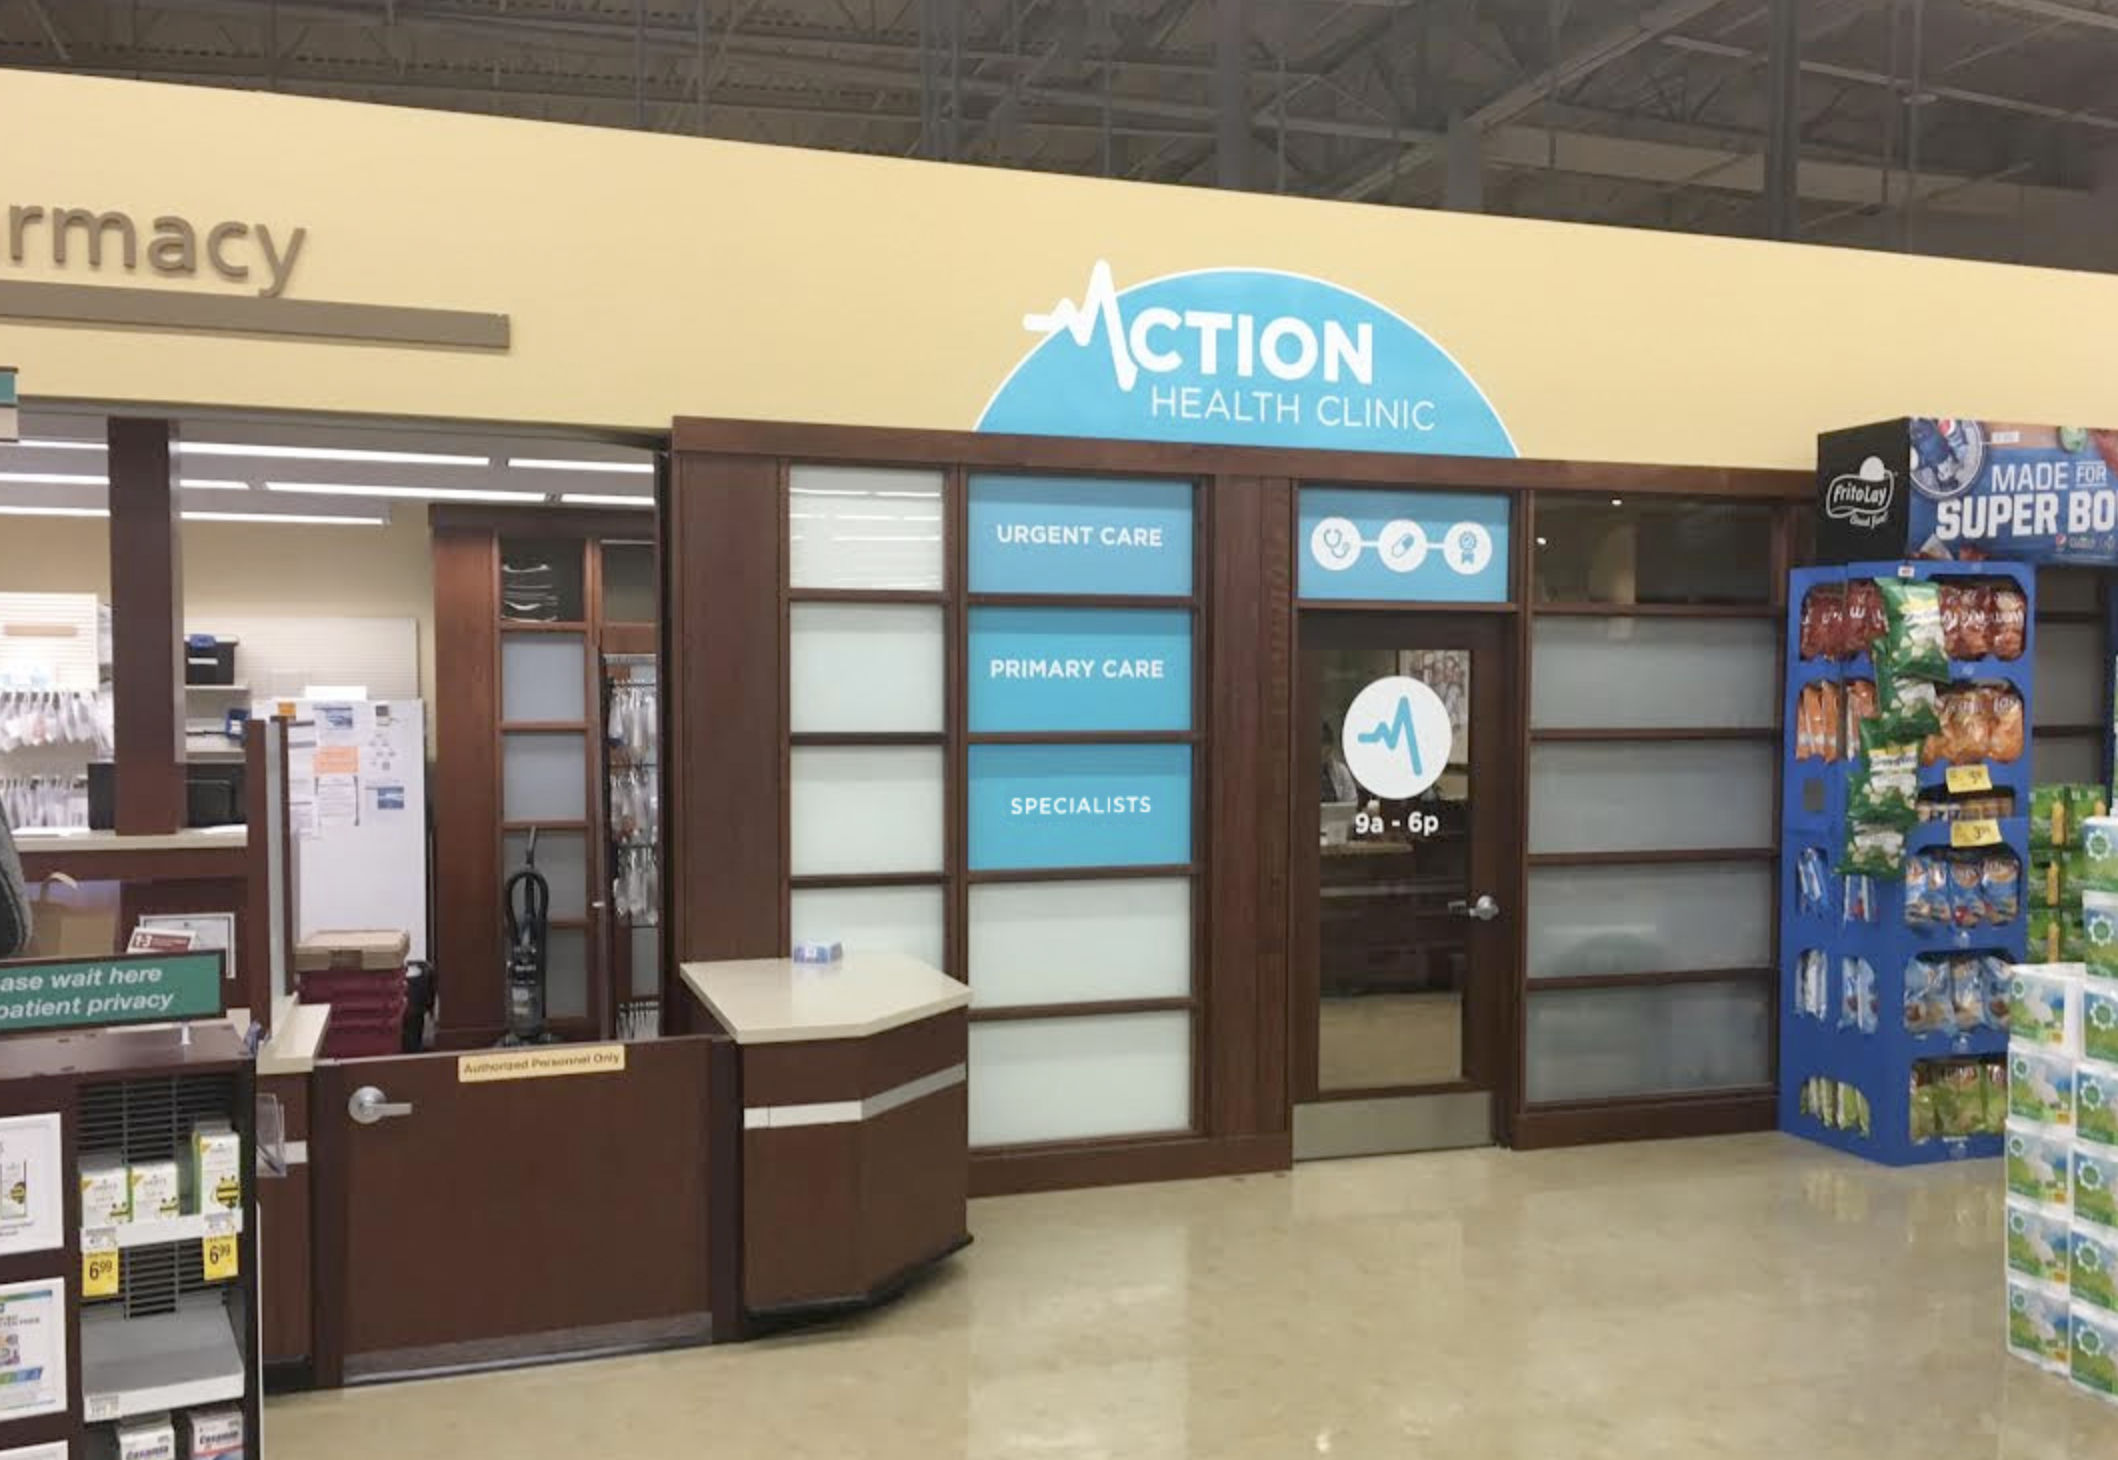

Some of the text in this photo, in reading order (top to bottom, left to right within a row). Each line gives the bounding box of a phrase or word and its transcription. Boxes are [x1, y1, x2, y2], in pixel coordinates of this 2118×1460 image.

[8, 203, 307, 298] rmacy
[1151, 385, 1436, 432] HEALTH CLINIC
[1990, 462, 2106, 493] MADE FOR
[1936, 490, 2118, 541] SUPER BO
[996, 524, 1163, 547] URGENT CARE
[990, 658, 1165, 679] PRIMARY CARE
[1010, 795, 1152, 815] SPECIALISTS
[1355, 812, 1384, 833] 9a
[1407, 811, 1439, 836] 6p
[51, 968, 103, 988] wait
[109, 966, 163, 985] here
[87, 993, 175, 1016] privacy
[463, 1052, 620, 1075] Authorized Personnel Only
